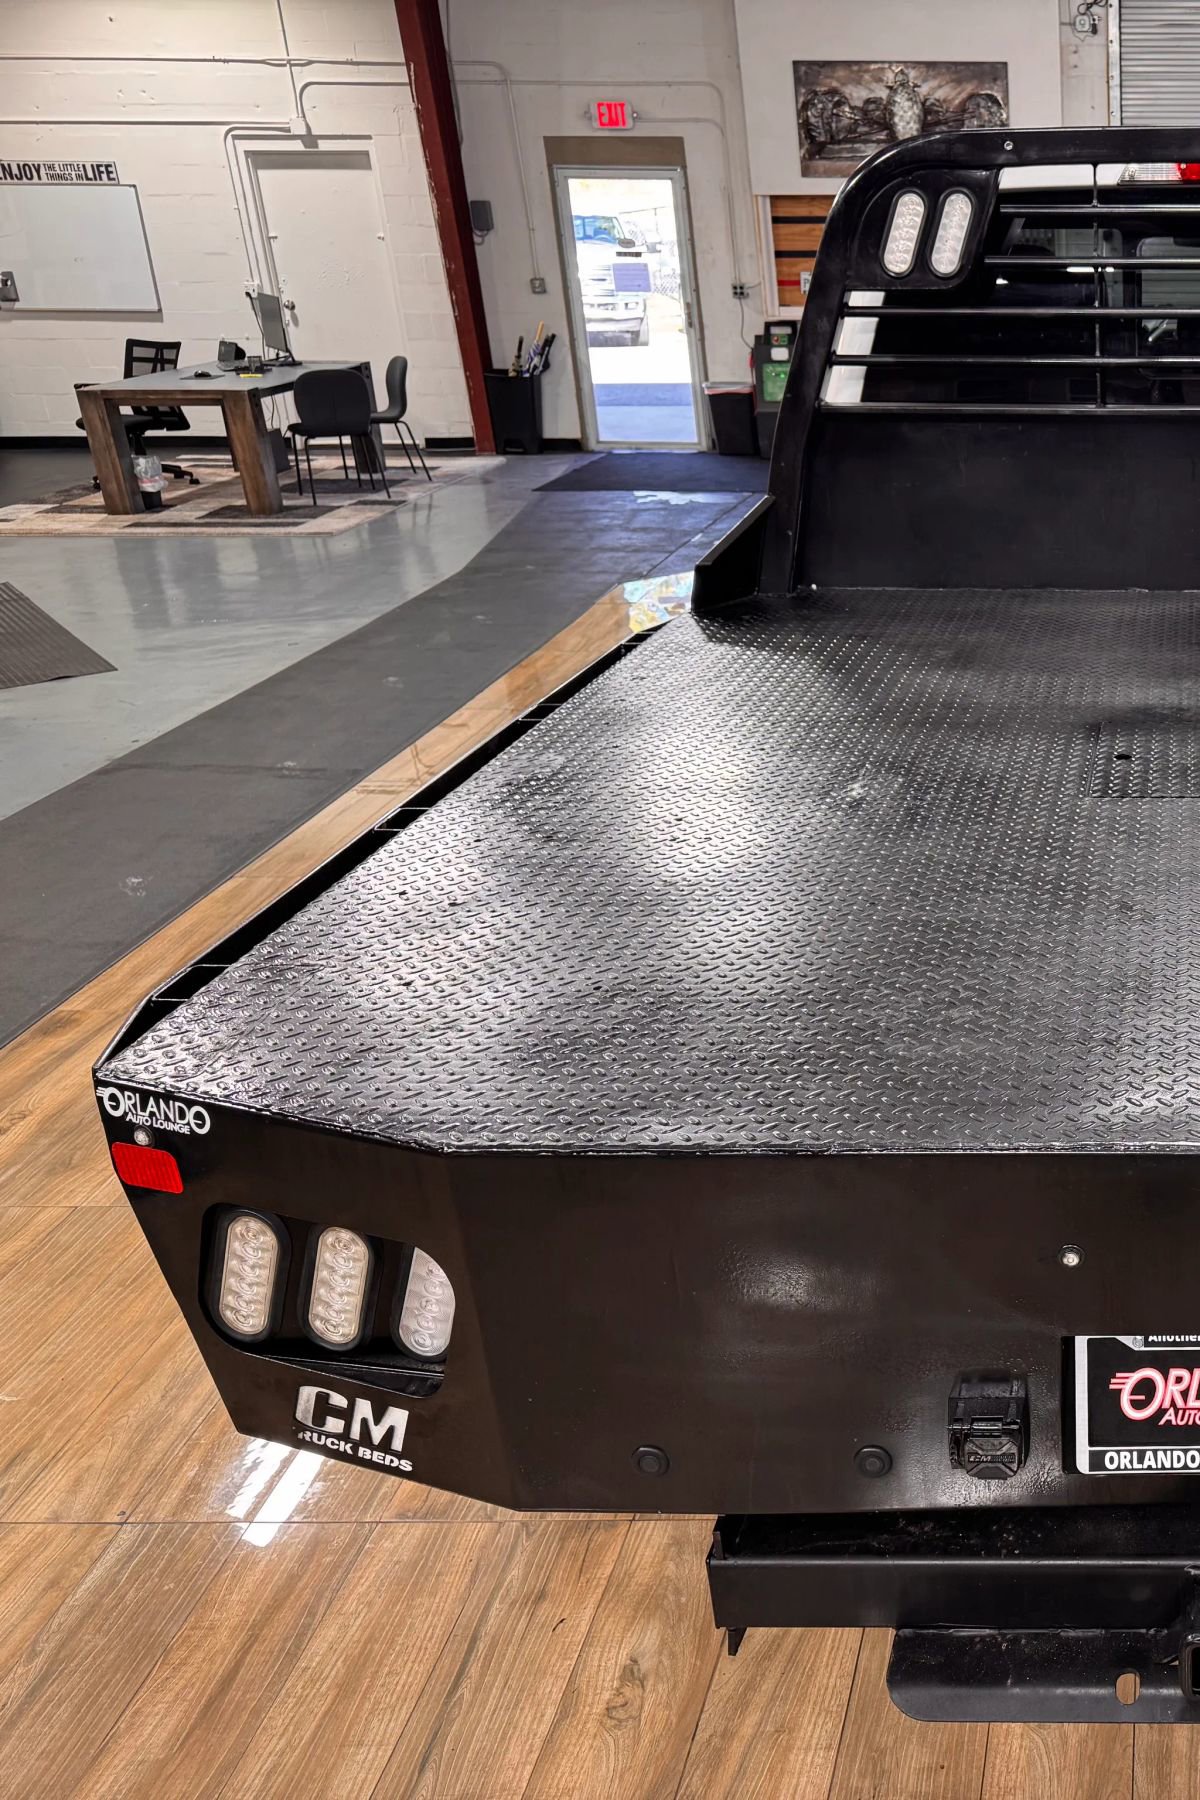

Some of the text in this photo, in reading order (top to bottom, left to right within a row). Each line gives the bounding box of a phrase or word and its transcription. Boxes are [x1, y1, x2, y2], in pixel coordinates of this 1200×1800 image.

[597, 102, 626, 127] EXIT
[0, 163, 42, 181] NJOY
[43, 163, 82, 172] THE LITTLE
[45, 172, 84, 181] THINGS IN
[82, 163, 116, 181] LIFE
[98, 1087, 211, 1135] ORLANDO
[126, 1111, 191, 1135] AUTO LOUNGE
[295, 1385, 410, 1452] CM
[296, 1430, 413, 1472] RUCK BEDS
[1104, 1450, 1200, 1470] ORLANDO
